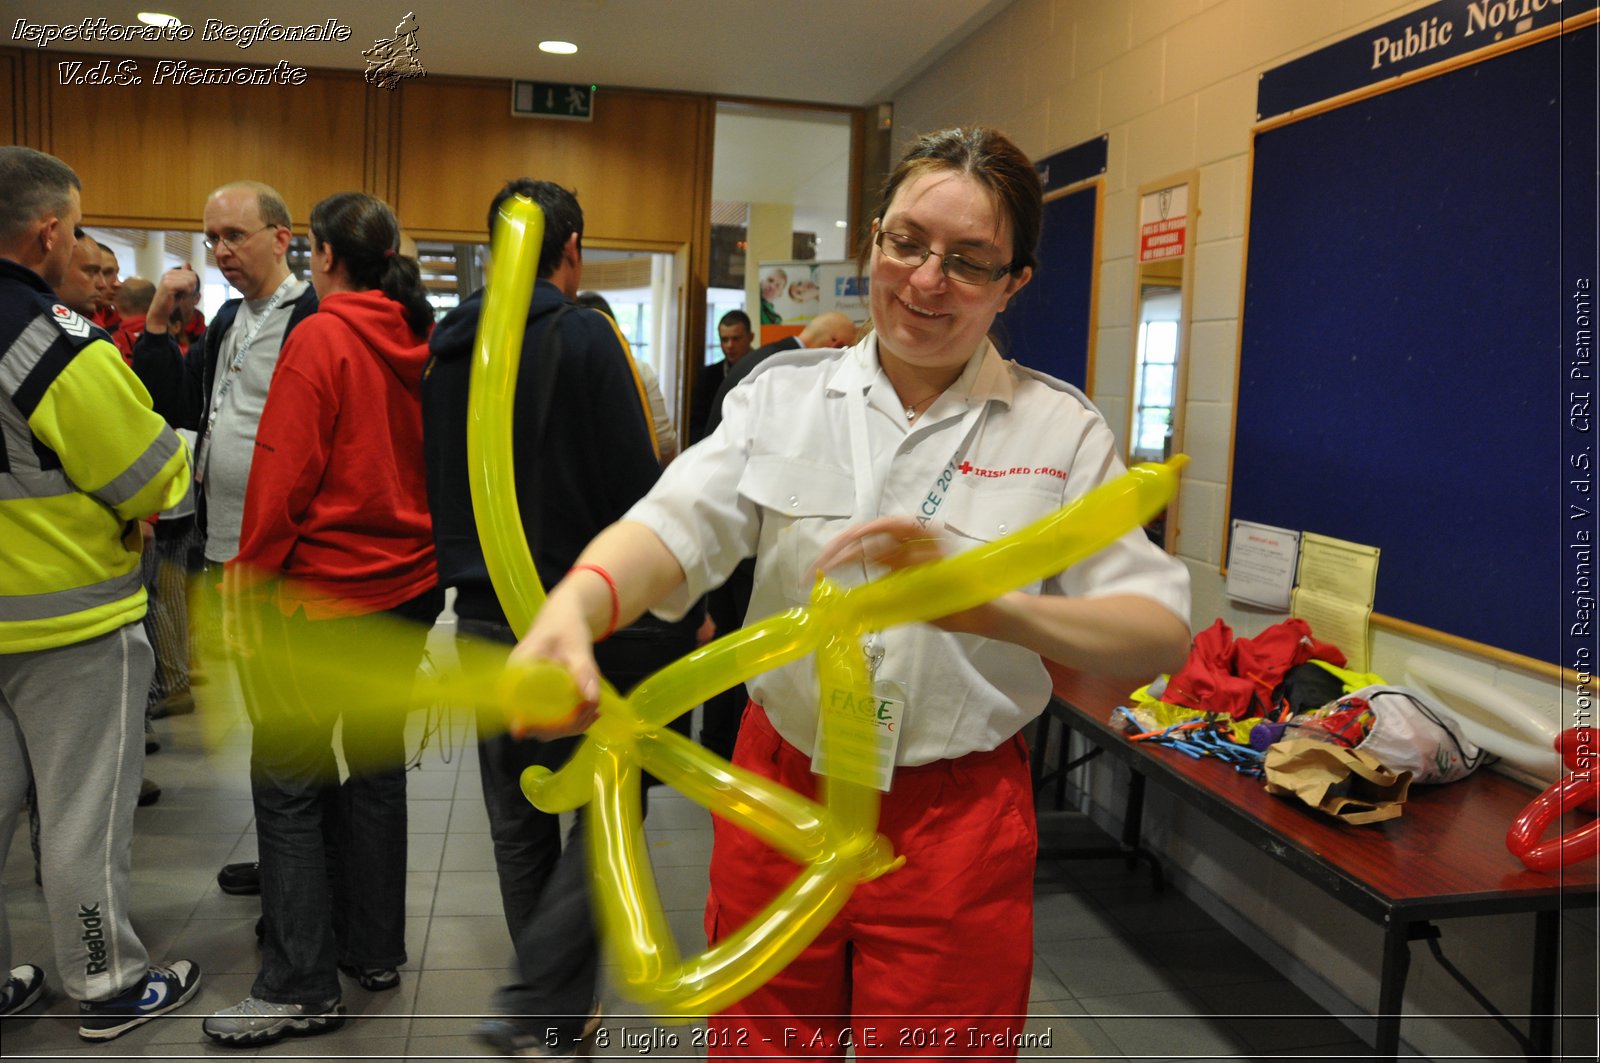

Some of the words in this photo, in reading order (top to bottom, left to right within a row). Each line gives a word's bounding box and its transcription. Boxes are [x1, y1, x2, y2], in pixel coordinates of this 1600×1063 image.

[1371, 17, 1453, 70] Public
[1464, 0, 1562, 37] Notic
[975, 468, 1006, 478] IRISH
[1009, 467, 1031, 475] RED
[914, 491, 942, 530] ACE
[78, 901, 107, 976] Reebok
